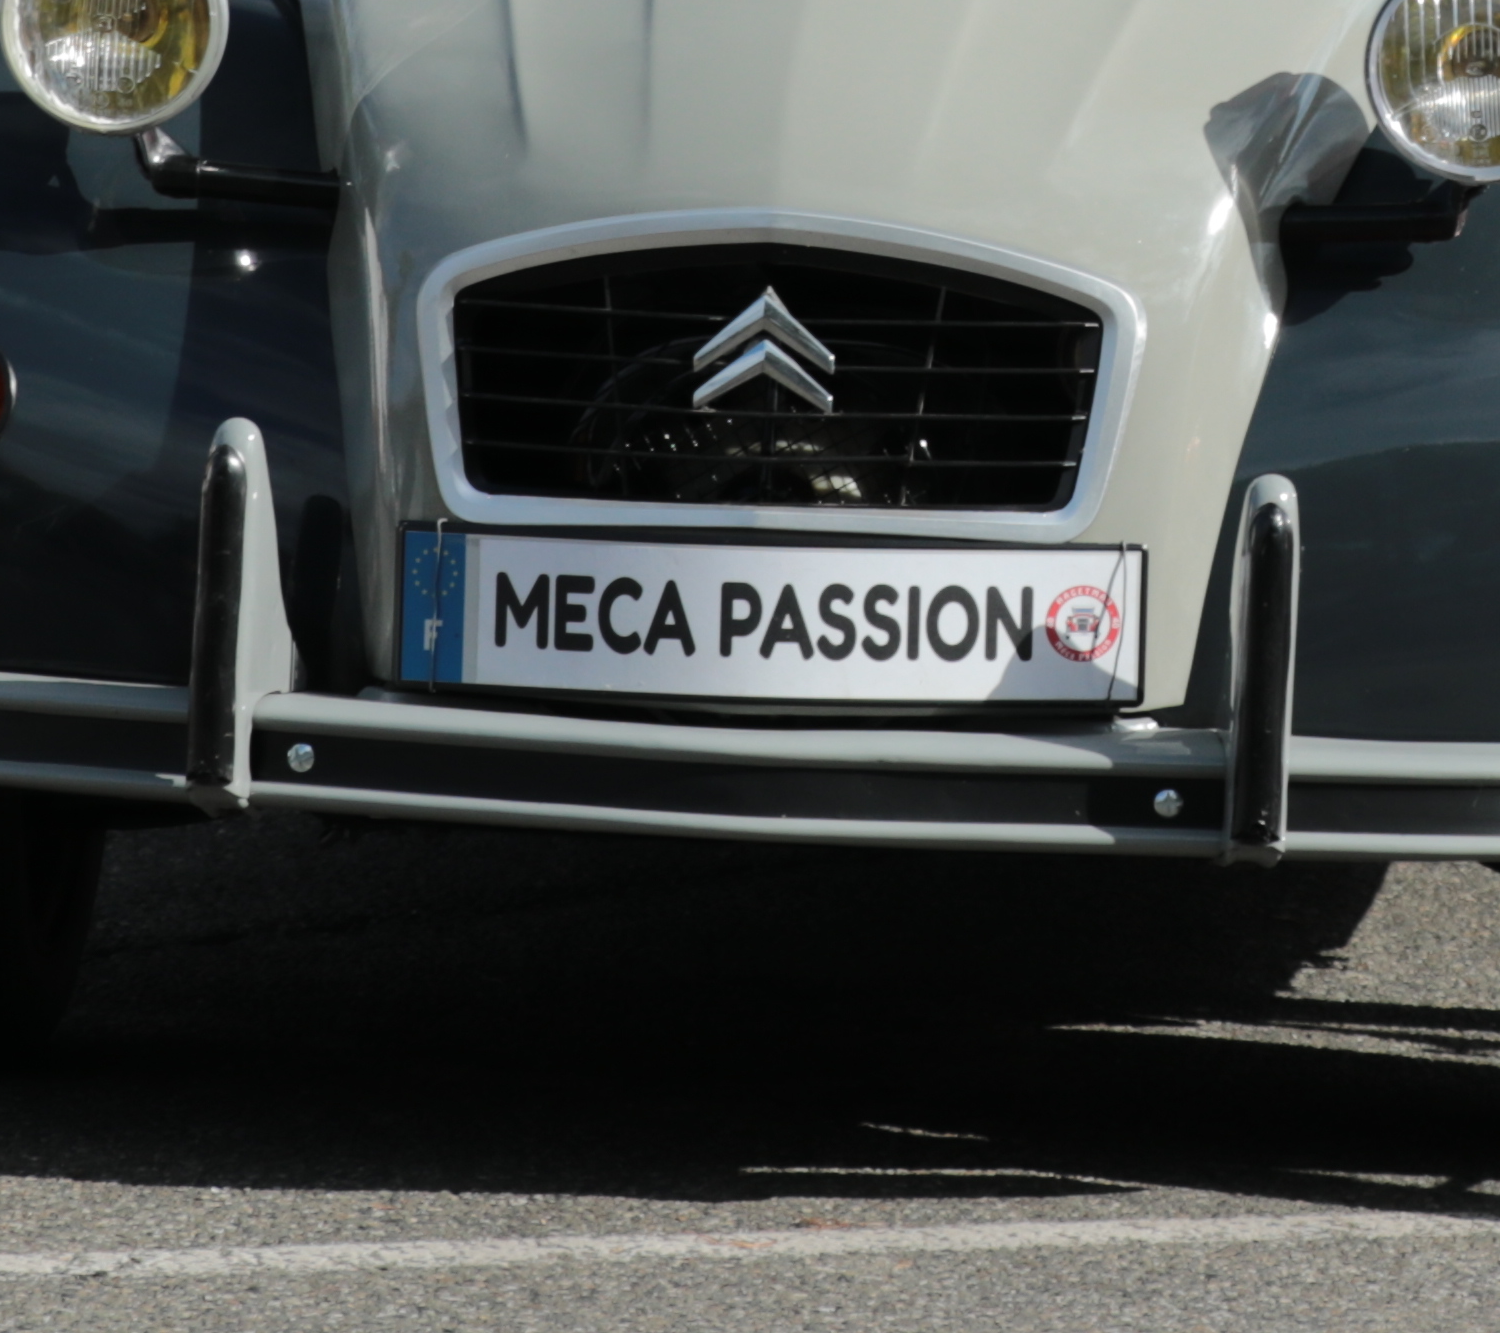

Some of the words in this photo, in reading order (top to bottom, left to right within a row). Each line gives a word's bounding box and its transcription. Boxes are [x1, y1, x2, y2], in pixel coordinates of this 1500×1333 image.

[422, 618, 443, 652] F
[494, 571, 696, 658] MECA
[720, 580, 1034, 662] PASSION
